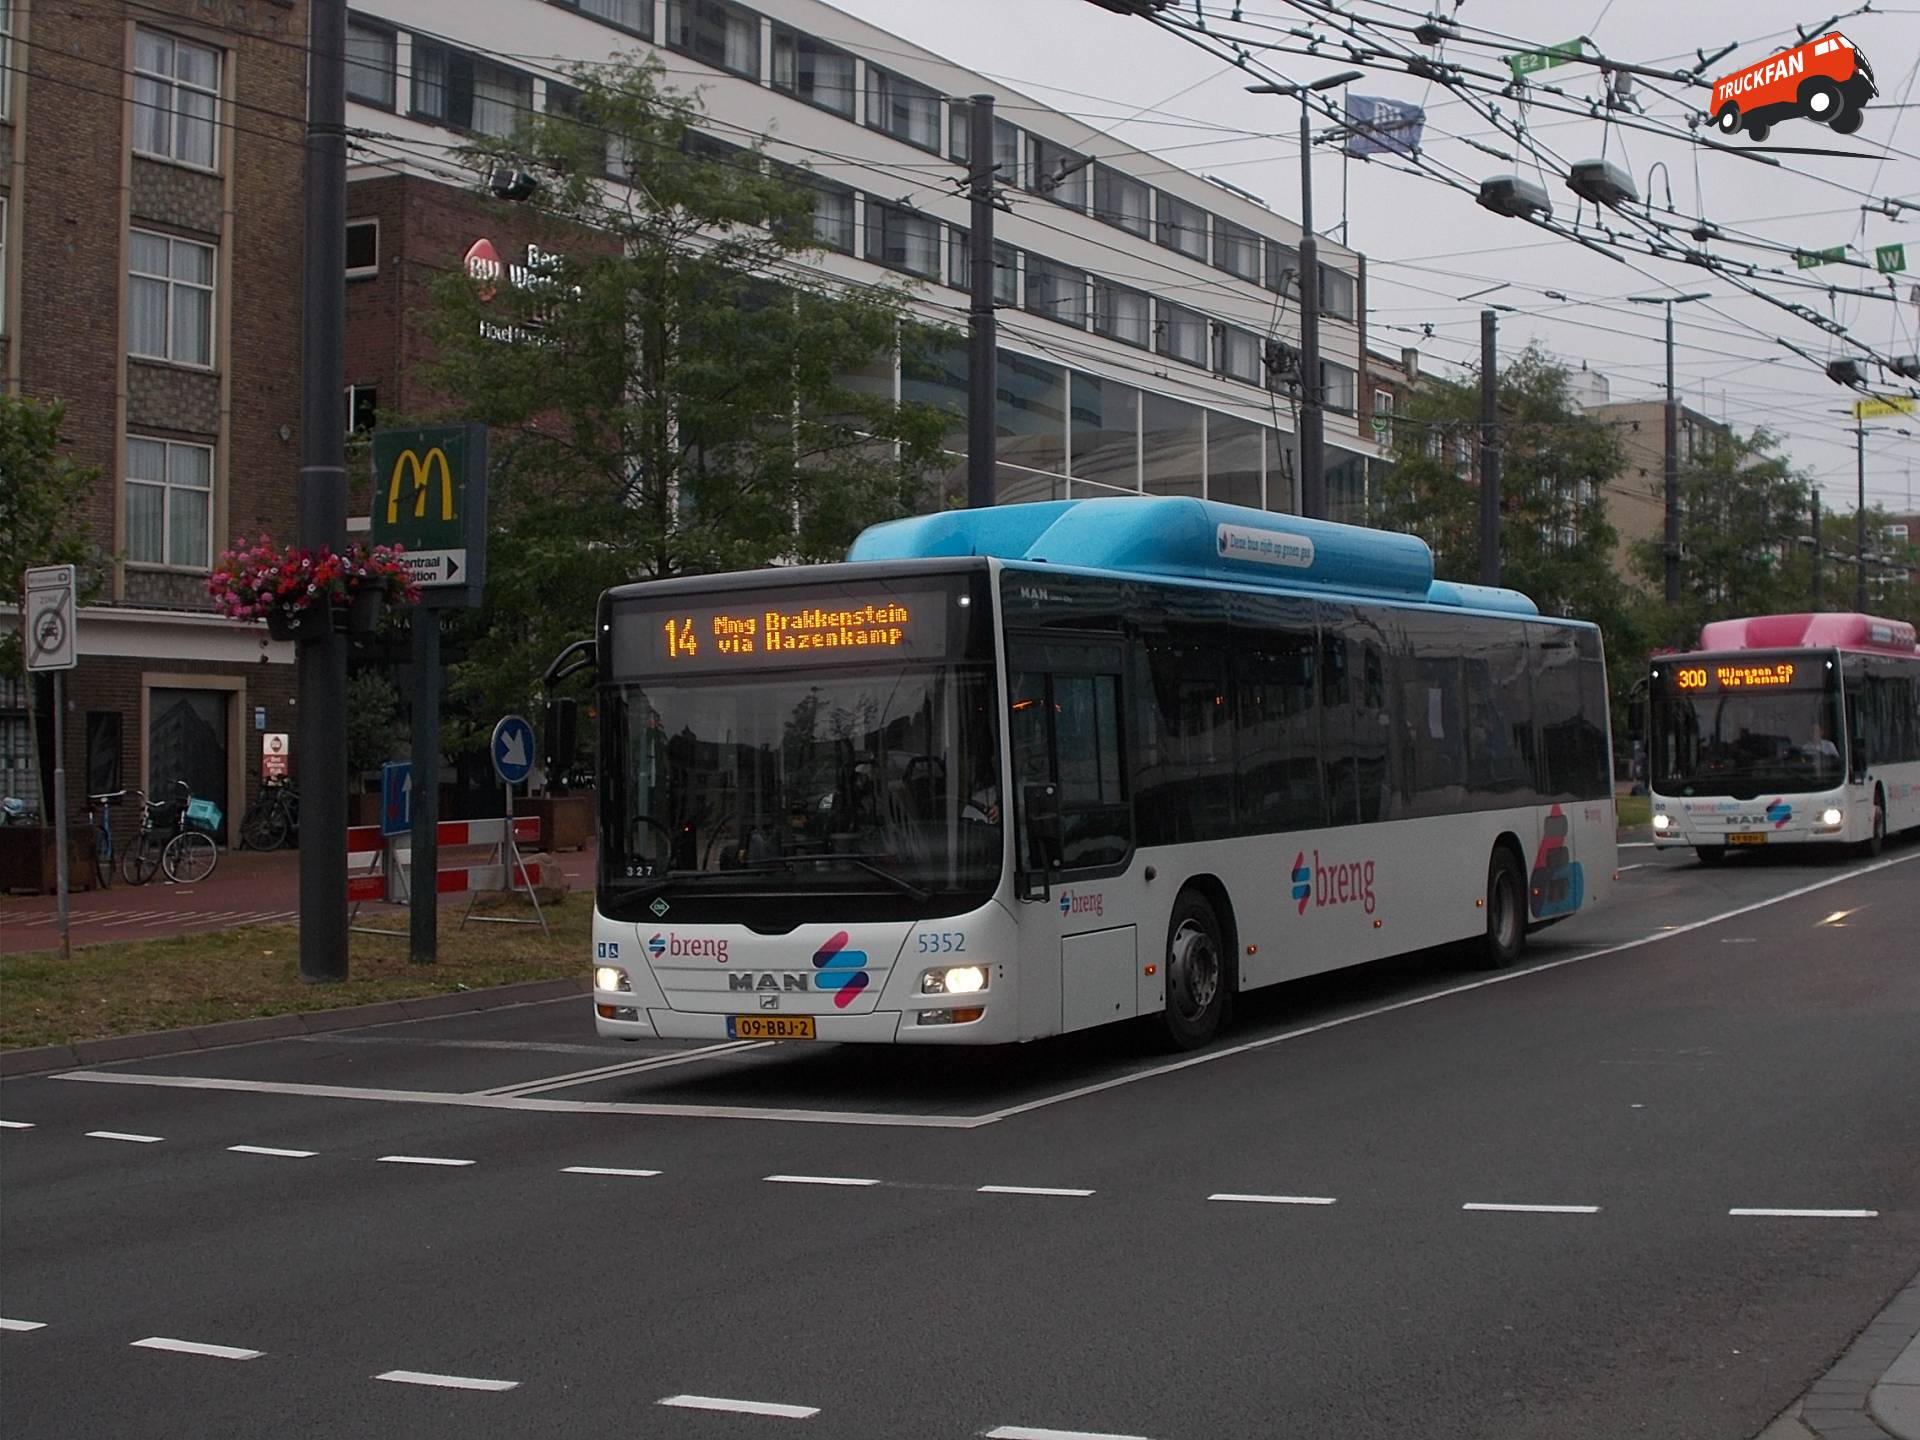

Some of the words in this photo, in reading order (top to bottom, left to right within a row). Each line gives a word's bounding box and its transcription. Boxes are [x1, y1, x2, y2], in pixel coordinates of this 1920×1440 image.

[1881, 250, 1900, 269] W
[1020, 586, 1048, 601] MAN
[765, 603, 908, 632] Brakkenstein
[664, 618, 698, 657] 14
[718, 634, 754, 653] via
[765, 627, 903, 651] Hazenkamp
[1679, 669, 1708, 688] 300
[1777, 664, 1794, 676] CS
[1722, 676, 1741, 686] via
[1725, 815, 1766, 824] MAN
[626, 866, 653, 877] 327
[1314, 849, 1376, 915] breng
[1071, 889, 1104, 917] breng
[670, 932, 729, 964] breng
[918, 932, 966, 954] 5352
[728, 972, 809, 992] MAN
[741, 1020, 809, 1036] 09-BBJ-2
